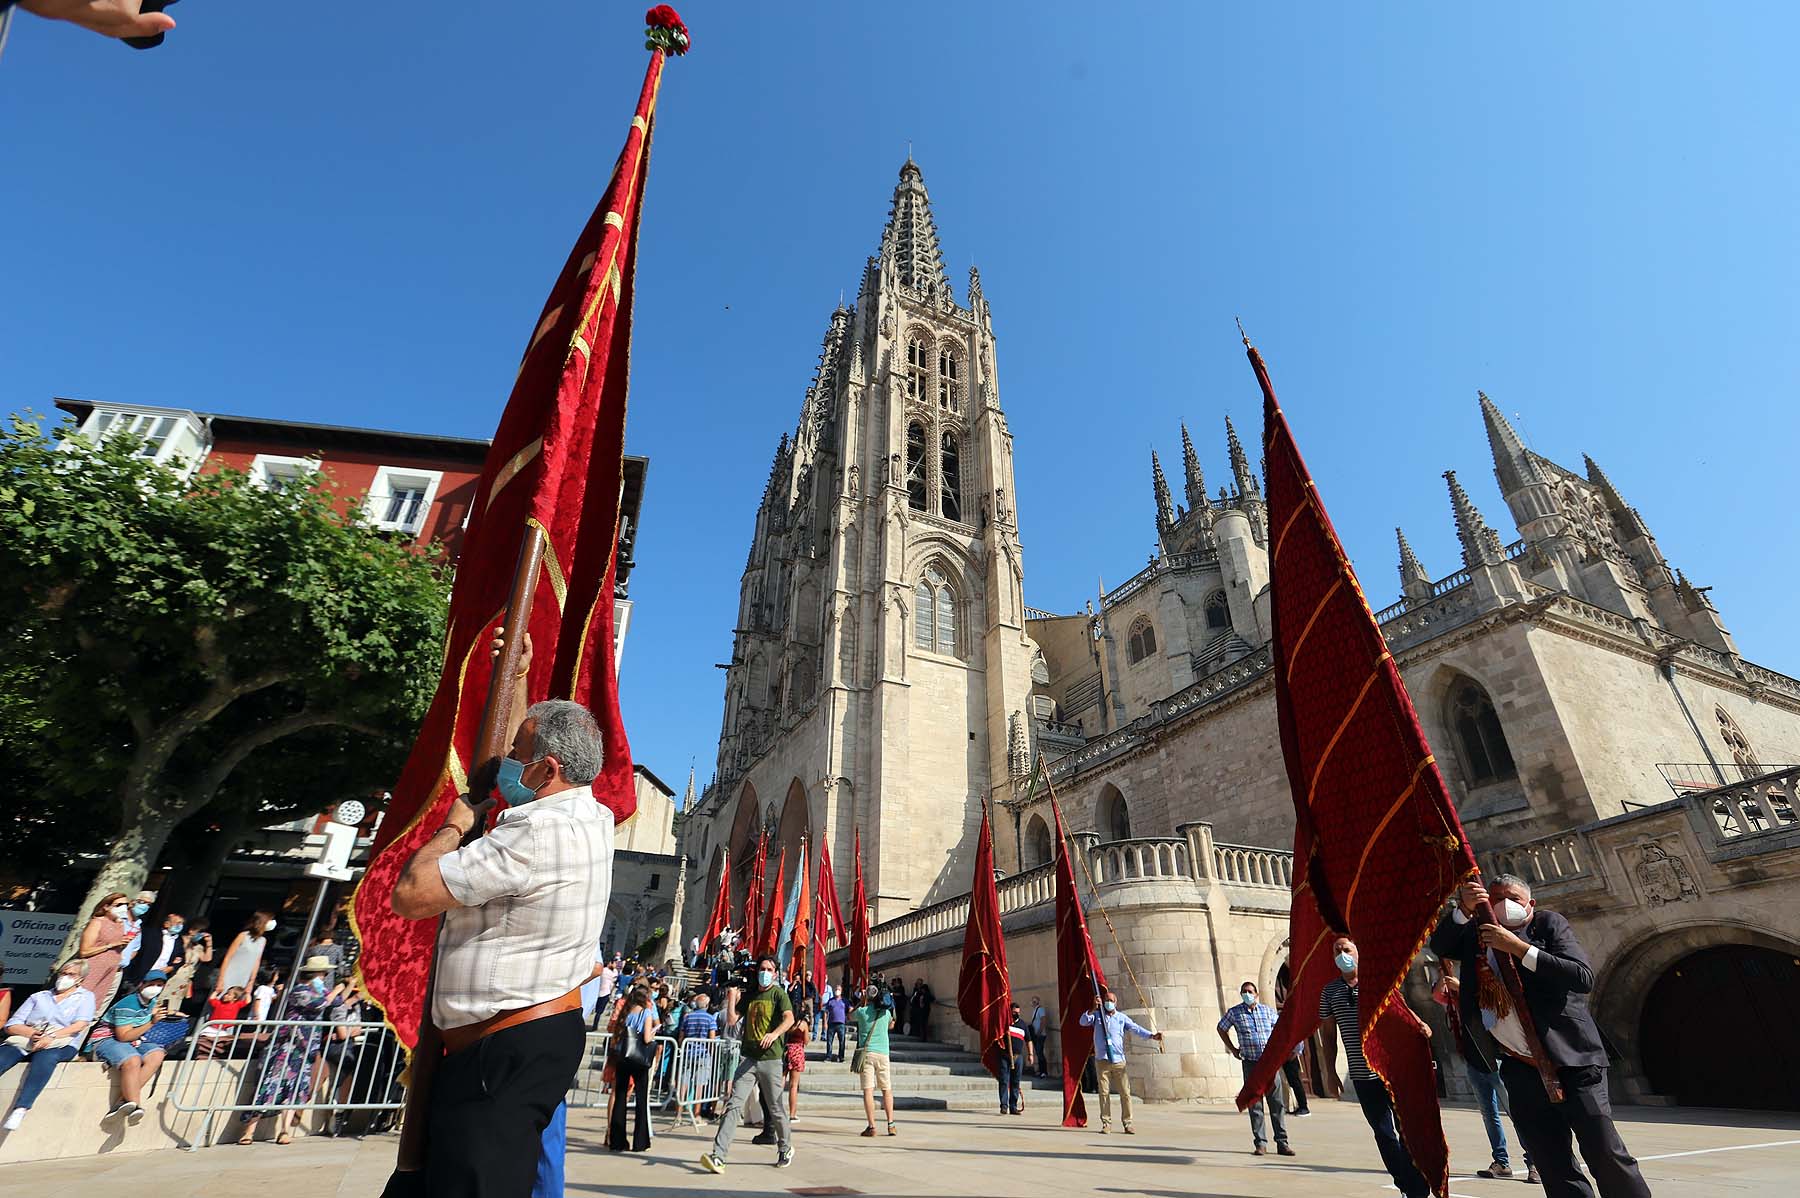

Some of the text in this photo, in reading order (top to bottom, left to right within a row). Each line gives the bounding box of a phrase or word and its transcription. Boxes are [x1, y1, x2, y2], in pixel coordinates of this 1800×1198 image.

[11, 919, 56, 931] Oficina
[12, 934, 63, 946] Turismo
[4, 950, 32, 958] Tourist
[3, 967, 29, 975] etros
